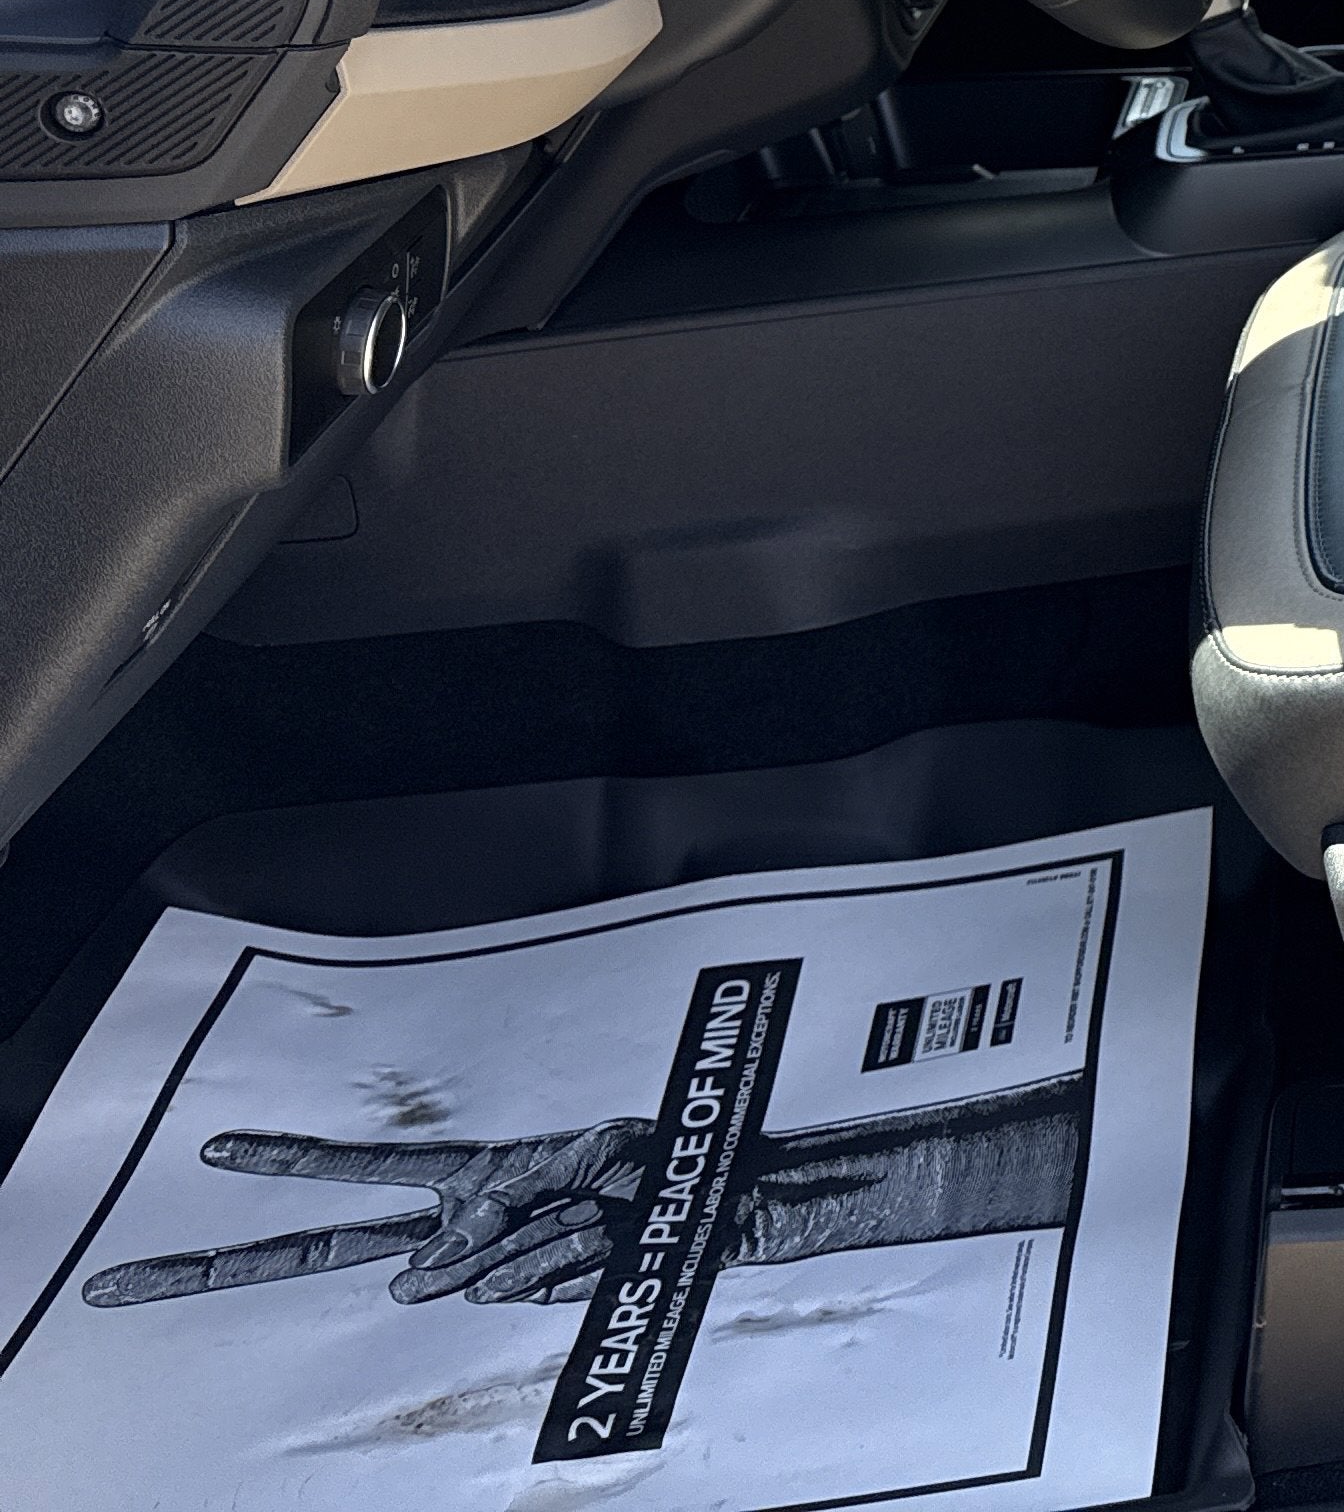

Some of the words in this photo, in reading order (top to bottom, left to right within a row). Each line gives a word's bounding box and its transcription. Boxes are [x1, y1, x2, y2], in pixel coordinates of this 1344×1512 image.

[693, 977, 753, 1070] MIND
[922, 1000, 943, 1054] UNLIMITED
[934, 997, 957, 1050] MILEAGE
[677, 1073, 730, 1129] OF
[722, 1059, 759, 1150] COMMERCIAL
[715, 1150, 735, 1171] NO
[638, 1131, 715, 1247] PEACE
[699, 1172, 729, 1223] LABOR.
[638, 1250, 666, 1272] =
[676, 1223, 713, 1286] INCLUDES
[576, 1276, 664, 1408] YEARS
[625, 1351, 668, 1436] UNLIMITED
[565, 1412, 616, 1442] 2
